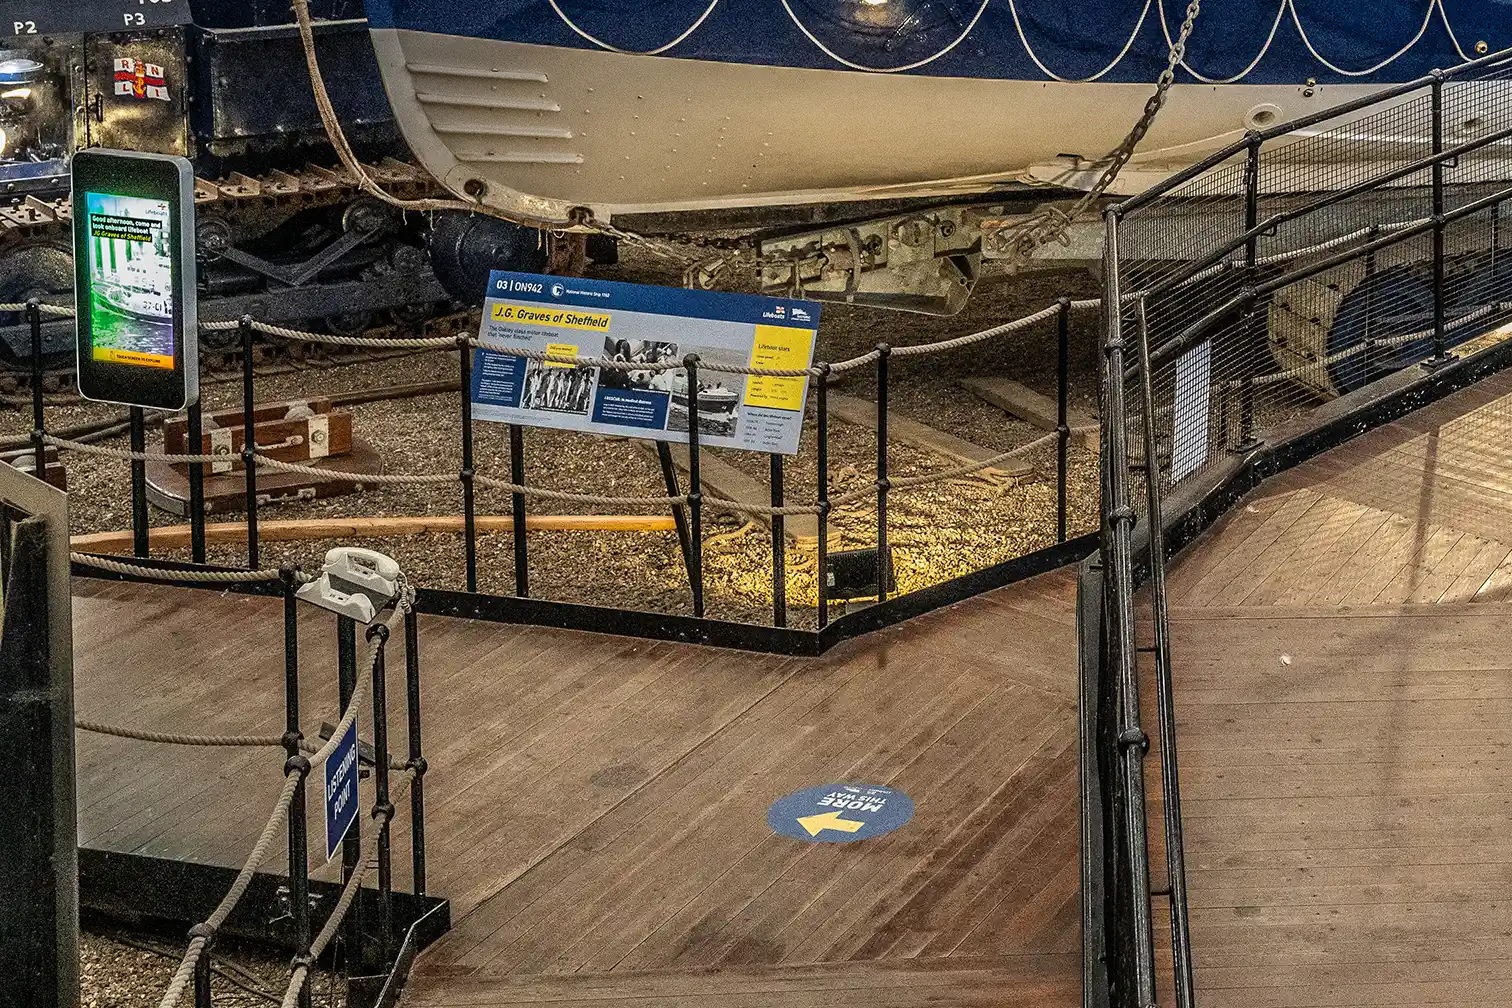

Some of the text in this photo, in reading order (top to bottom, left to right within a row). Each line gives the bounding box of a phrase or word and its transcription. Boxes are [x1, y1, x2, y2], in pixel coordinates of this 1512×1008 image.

[123, 12, 146, 26] P3
[13, 20, 38, 35] P2
[92, 215, 106, 223] Good
[107, 217, 135, 227] afternoon,
[92, 222, 148, 235] look onboard lifeboat
[101, 230, 120, 238] Graves
[127, 233, 152, 243] Sheffield
[496, 279, 543, 294] 03 ON942
[495, 307, 609, 329] J.G. Graves of Sheffield
[327, 743, 356, 801] LISTENING
[334, 778, 351, 821] POINT
[826, 791, 857, 801] WAY
[858, 795, 887, 805] THIS
[816, 796, 884, 813] MORE
